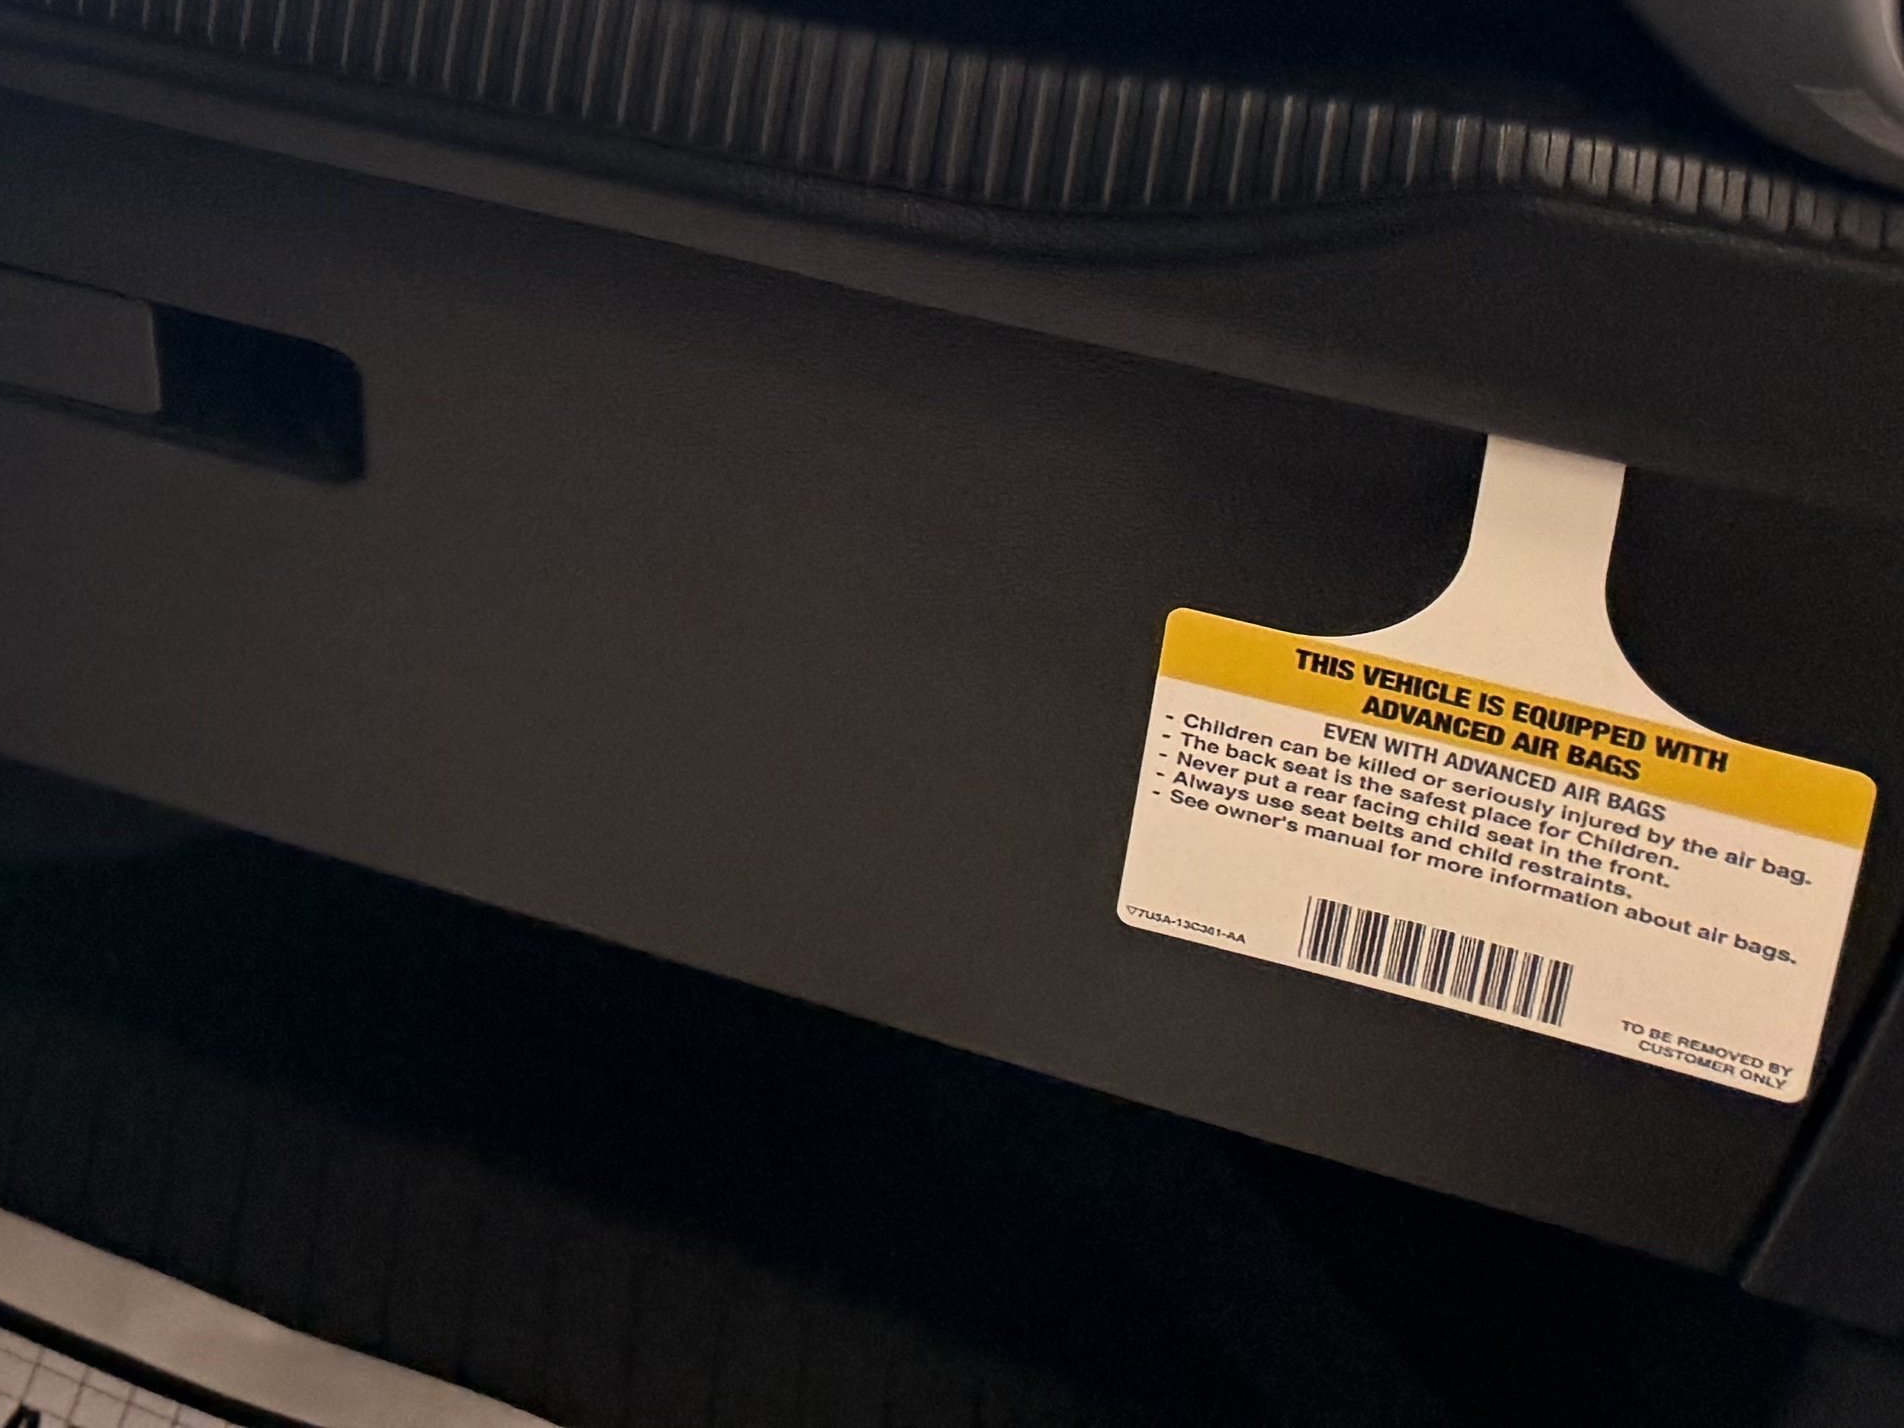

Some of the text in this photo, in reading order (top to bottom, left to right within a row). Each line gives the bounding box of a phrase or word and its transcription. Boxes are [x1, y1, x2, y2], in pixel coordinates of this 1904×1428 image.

[1295, 648, 1729, 773] THIS VEHICLE IS EQUIPPED WITH
[1323, 722, 1667, 822] EVEN WITH ADVANCED AIR BAGS
[1360, 695, 1642, 781] ADVANCED AIR BAGS
[1172, 771, 1632, 899] Always use seat belts and child restraints.
[1176, 750, 1670, 889] Never put a rear facing child seat in the front.
[1180, 731, 1680, 870] The back seat is the safest place for Children.
[1183, 713, 1812, 886] Children can be killed or seriously injured by the air bag.
[1170, 788, 1797, 965] See owner's manual for more information about air bags.
[1621, 1020, 1795, 1077] TO BE REMOVED BY
[1638, 1039, 1787, 1090] CUSTOMER ONLY
